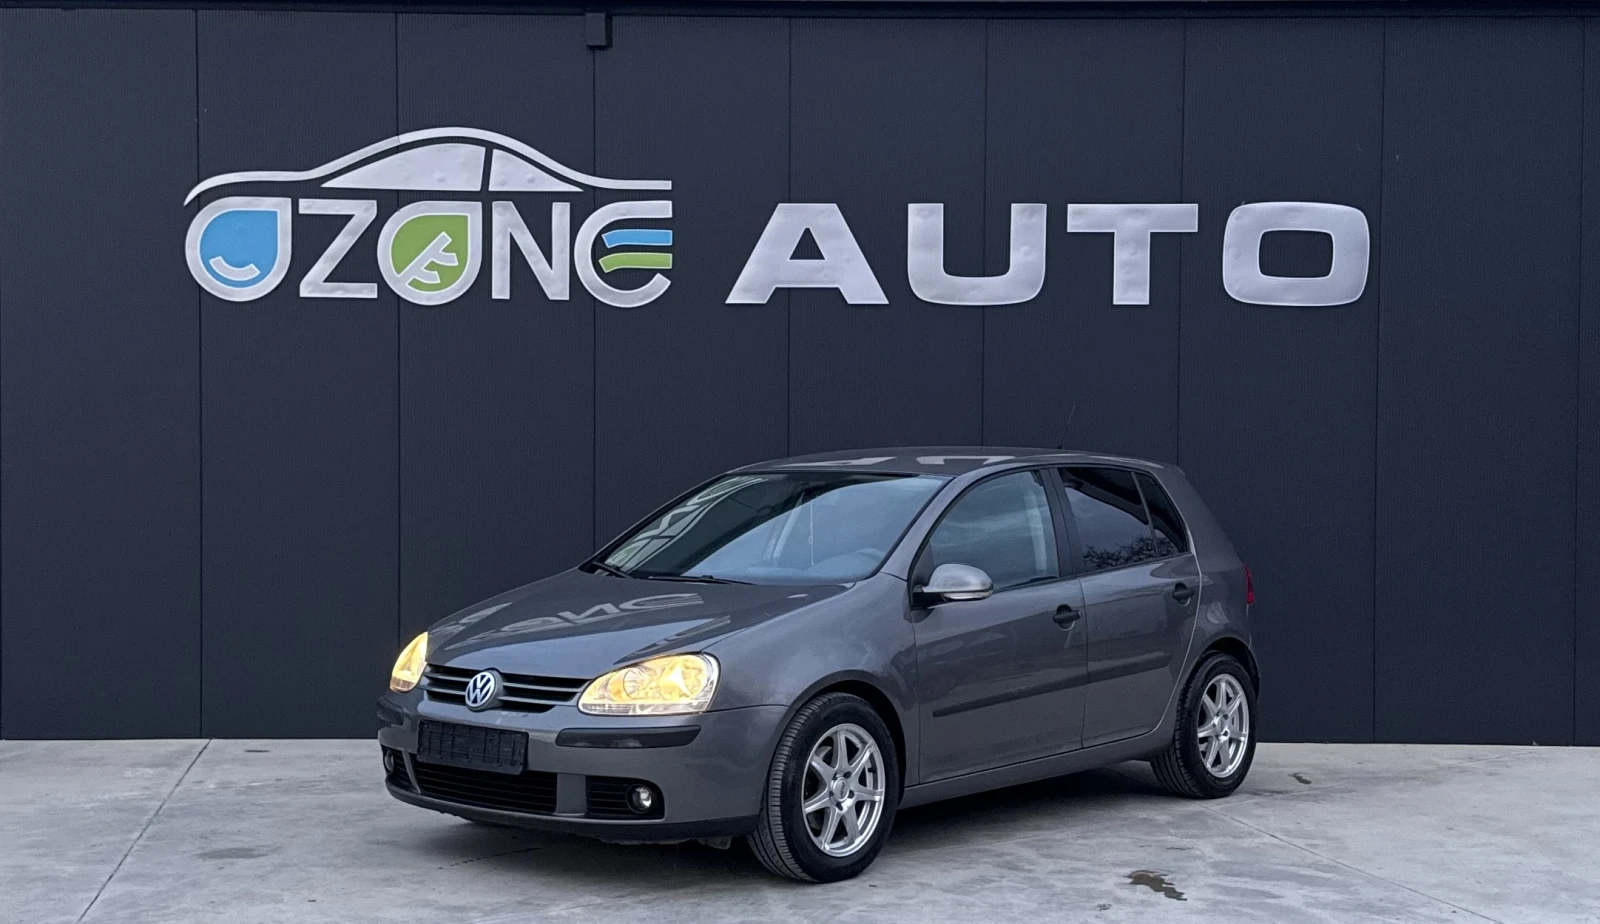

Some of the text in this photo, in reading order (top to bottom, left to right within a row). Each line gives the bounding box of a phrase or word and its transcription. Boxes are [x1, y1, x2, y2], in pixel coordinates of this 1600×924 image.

[185, 197, 1370, 308] OZONE AUTO
[465, 671, 495, 707] VW
